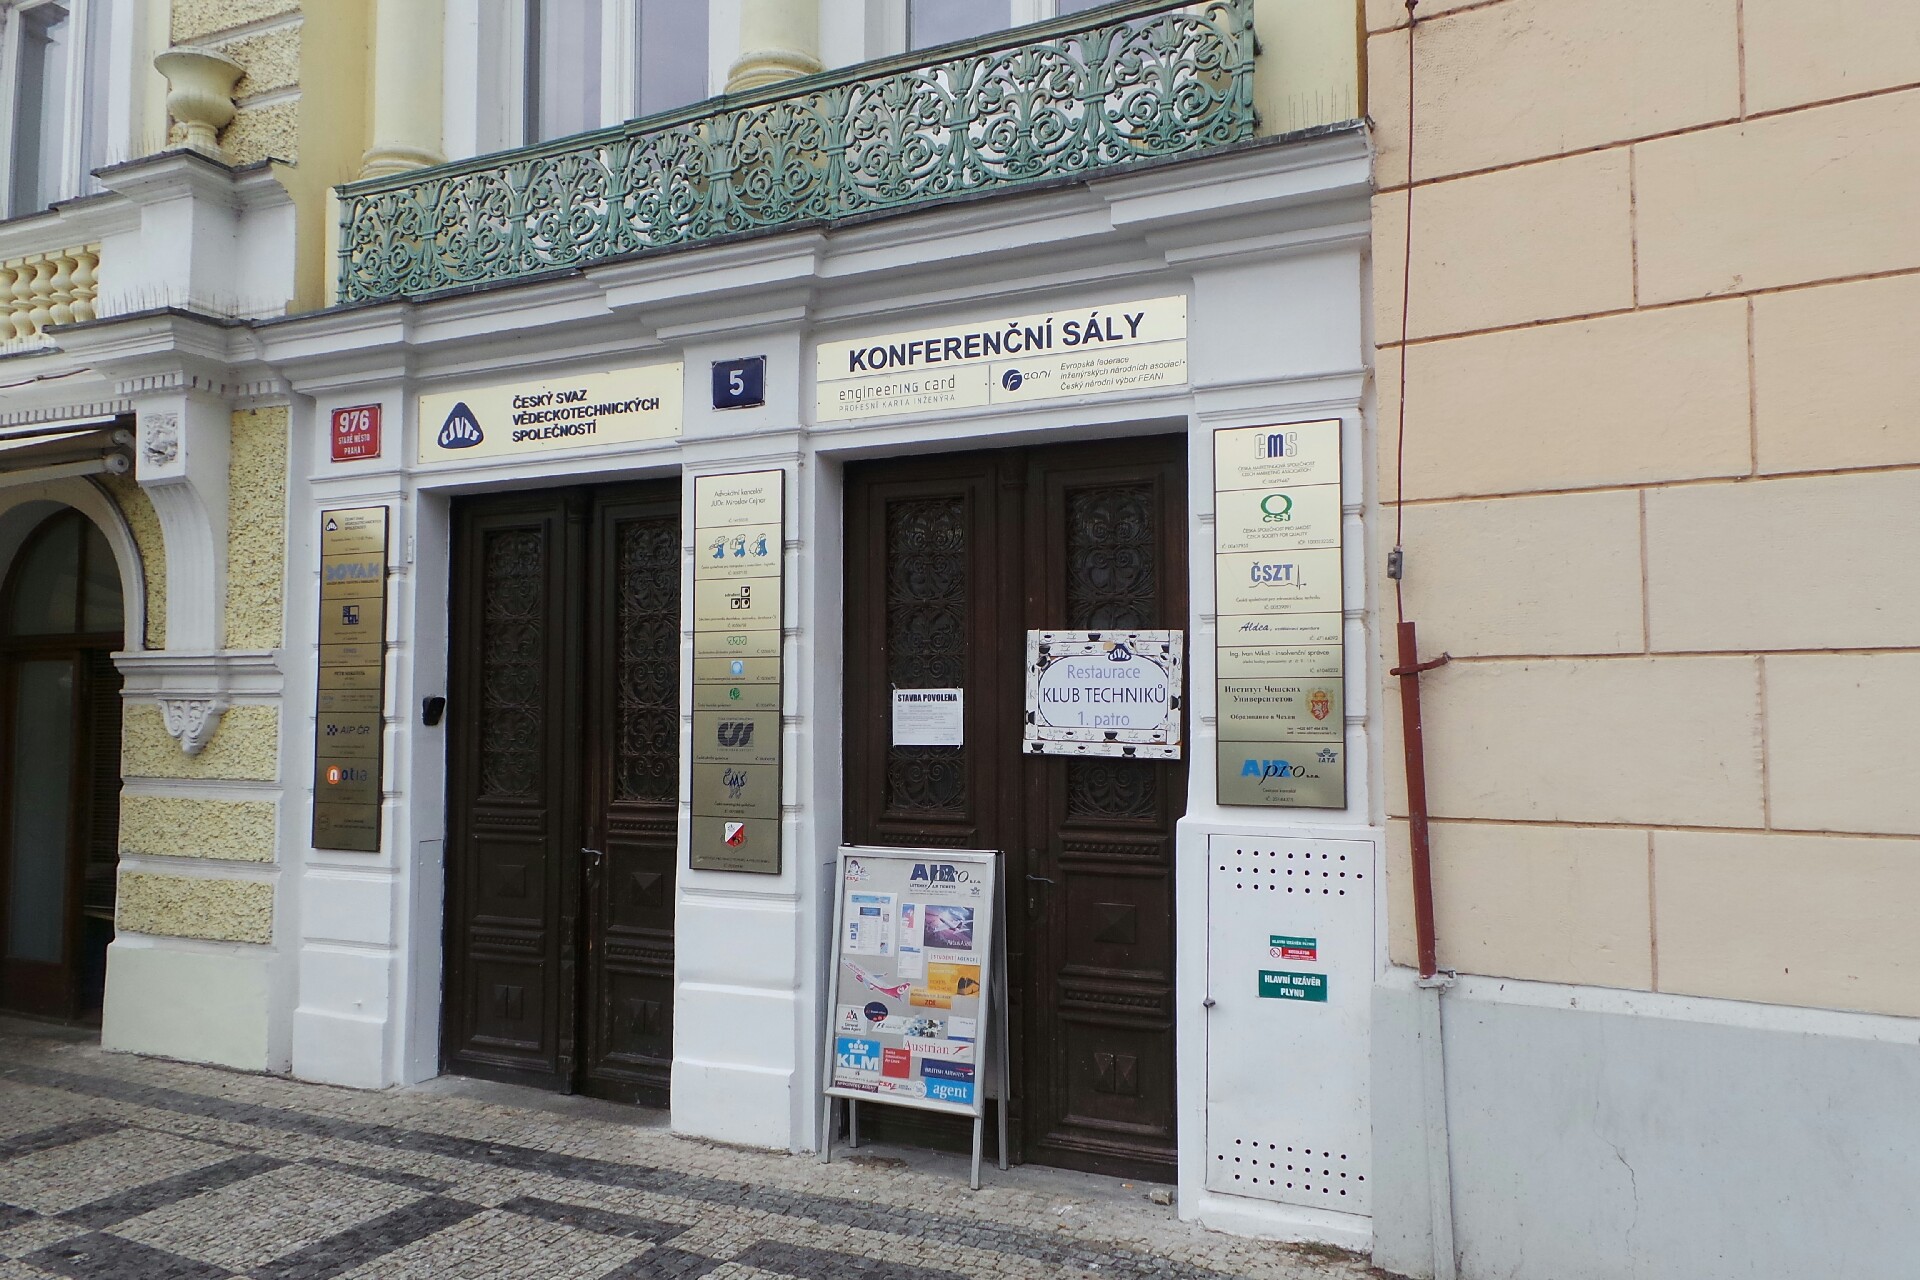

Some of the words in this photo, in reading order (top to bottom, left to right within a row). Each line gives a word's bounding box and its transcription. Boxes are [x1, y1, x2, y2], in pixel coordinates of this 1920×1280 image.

[850, 317, 1054, 372] KONFERENČNÍ
[1062, 311, 1145, 345] SÁLY
[1060, 359, 1095, 371] Evropská
[1110, 362, 1148, 374] národních
[729, 369, 744, 396] 5
[924, 374, 955, 391] card
[1060, 378, 1084, 391] Český
[1085, 377, 1114, 388] národní
[1115, 375, 1137, 386] výbor
[1138, 372, 1164, 382] FEANI
[513, 391, 553, 409] ČESKÝ
[556, 389, 587, 404] SVAZ
[882, 398, 910, 408] KARTA
[512, 397, 660, 426] VĚDECKOTECHNICKÝCH
[339, 410, 370, 433] 976
[512, 419, 597, 442] SPOLEČNOSTÍ
[338, 434, 353, 445] STARÉ
[353, 432, 371, 444] MĚSTO
[344, 446, 361, 455] PRAHA
[1250, 561, 1293, 582] ČSZT
[1067, 664, 1141, 679] Restaurace
[1043, 687, 1080, 703] KLUB
[1085, 684, 1166, 703] TECHNIKŮ
[1224, 685, 1262, 694] Институт
[1264, 685, 1301, 693] Чешских
[898, 693, 921, 702] STAVBA
[922, 693, 958, 702] POVOLENA
[1233, 695, 1293, 704] Университетов
[1077, 711, 1089, 726] 1.
[1094, 713, 1130, 728] patro
[1264, 974, 1290, 984] HLAVNÍ
[1293, 975, 1321, 987] UZÁVĚR
[1280, 987, 1305, 997] PLYNU
[903, 1040, 949, 1055] Austrian
[837, 1053, 879, 1071] KLM
[924, 1067, 943, 1075] BRITISH
[933, 1084, 968, 1099] agent
